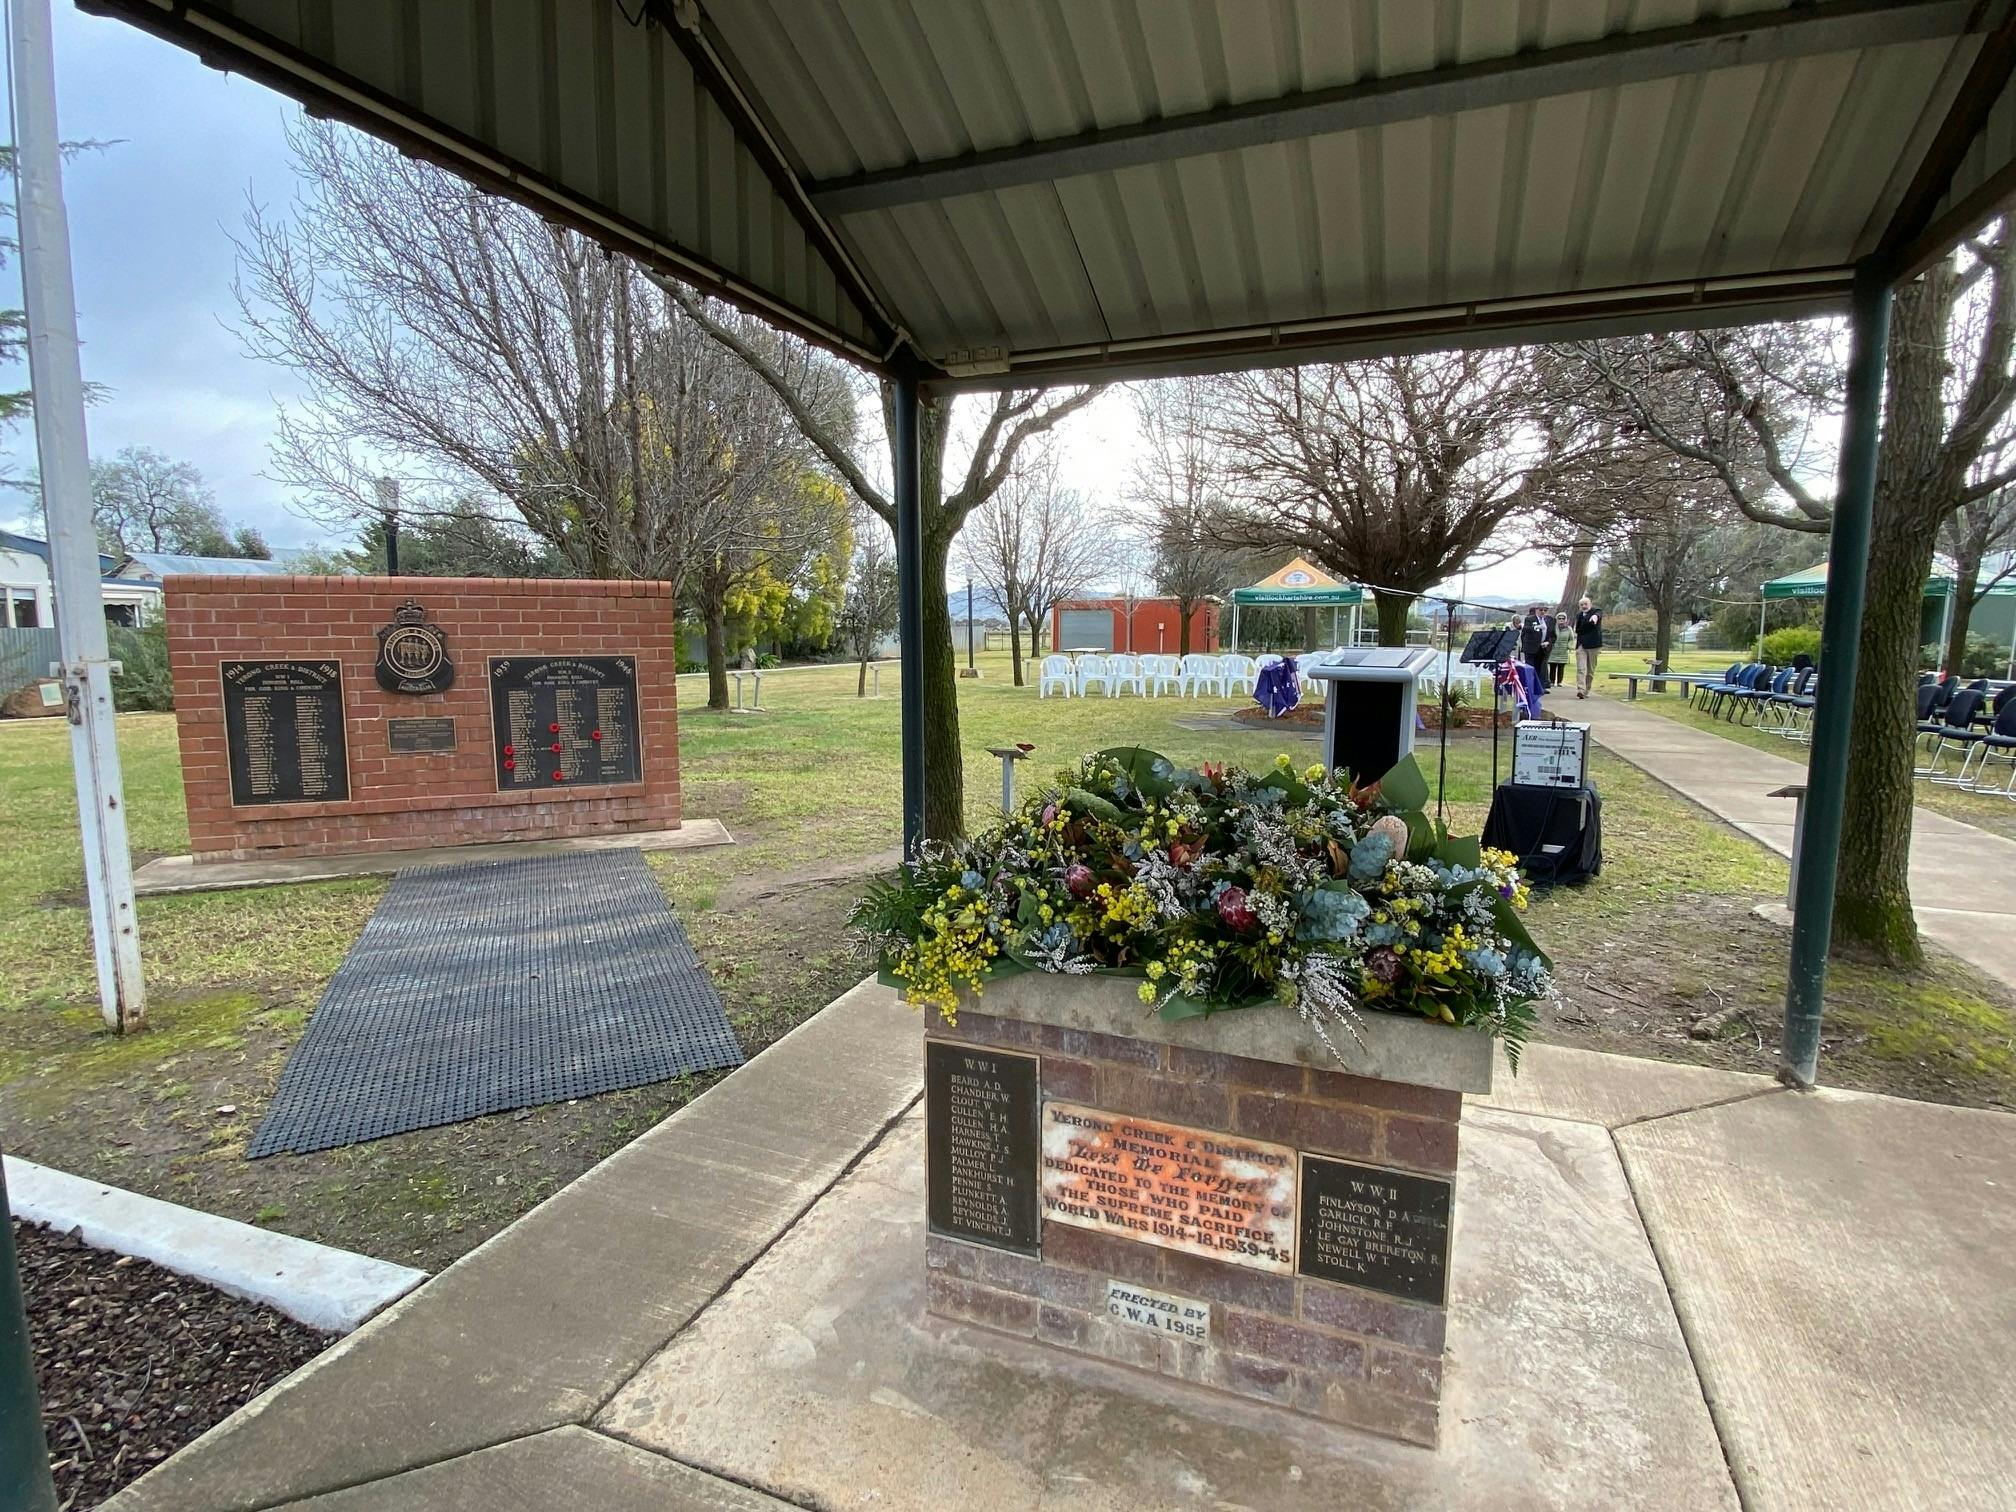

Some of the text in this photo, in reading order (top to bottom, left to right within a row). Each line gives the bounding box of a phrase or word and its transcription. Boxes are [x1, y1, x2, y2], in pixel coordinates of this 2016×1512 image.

[225, 664, 244, 680] 1914
[235, 668, 262, 685] YERONG
[264, 663, 289, 671] CREEK
[297, 666, 328, 684] DISTRICT
[319, 663, 338, 680] 1918
[494, 661, 511, 678] 1939
[549, 660, 572, 668] CREEK
[615, 659, 633, 675] 1945
[951, 1074, 980, 1087] BEARD
[1069, 1139, 1120, 1166] Lest
[1112, 1138, 1215, 1168] MEMORIAL
[1121, 1126, 1174, 1146] CREEK
[1203, 1140, 1288, 1168] DISTRICT
[1045, 1156, 1128, 1184] DEDICATED
[1134, 1177, 1152, 1190] TO
[1159, 1182, 1190, 1198] THE
[1196, 1190, 1264, 1213] MEMORY
[1085, 1179, 1244, 1223] THOSE WHO PAID
[1044, 1196, 1100, 1220] WORLD
[1104, 1210, 1149, 1232] WARS
[1060, 1187, 1275, 1245] THE SUPREME SACRIFICE
[1318, 1230, 1331, 1241] LE
[1337, 1235, 1360, 1248] GAY
[1110, 1288, 1207, 1321] ERECTED BY
[1165, 1318, 1206, 1340] 1952
